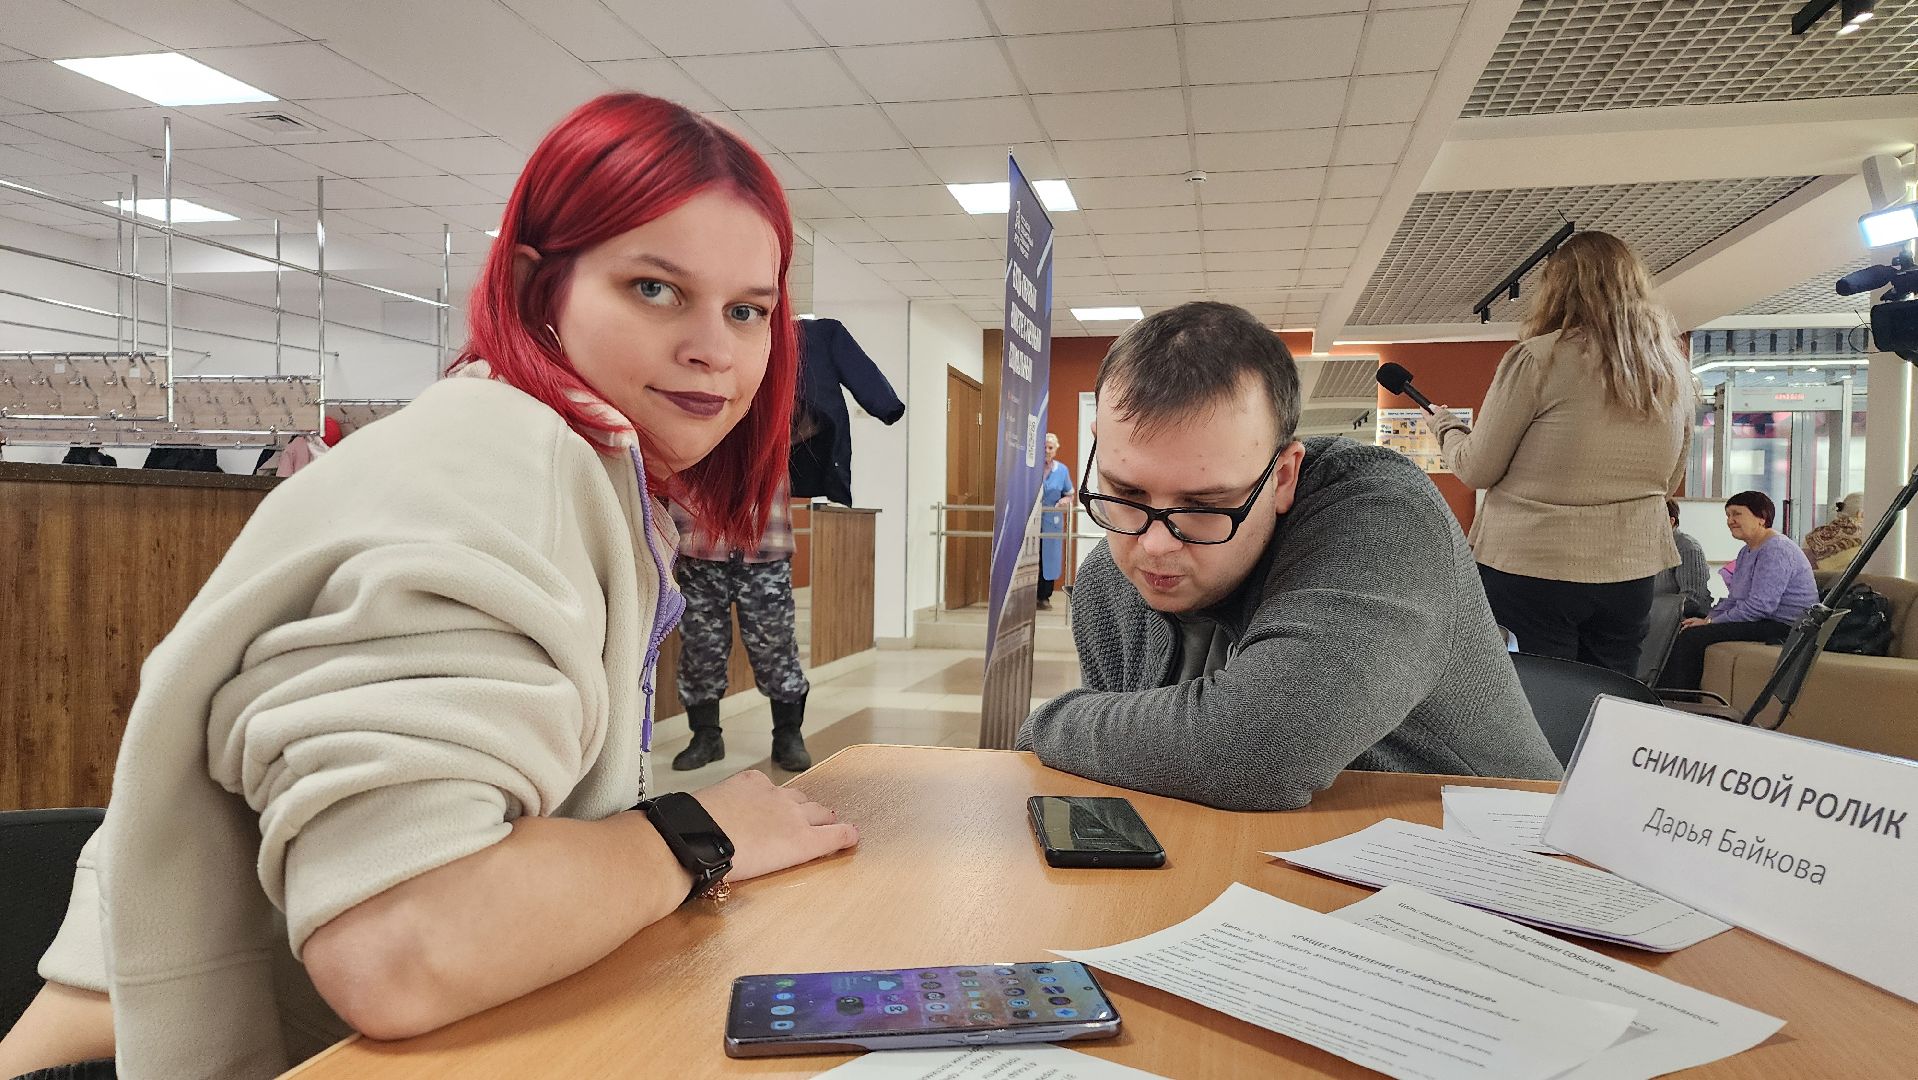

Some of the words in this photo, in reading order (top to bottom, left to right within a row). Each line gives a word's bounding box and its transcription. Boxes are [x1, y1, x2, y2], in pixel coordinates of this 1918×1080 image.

[1632, 746, 1717, 787] СНИМИ
[1720, 768, 1794, 808] СВОЙ
[1797, 787, 1908, 840] РОЛИК
[1642, 807, 1713, 847] Дарья
[1717, 828, 1828, 886] Байкова
